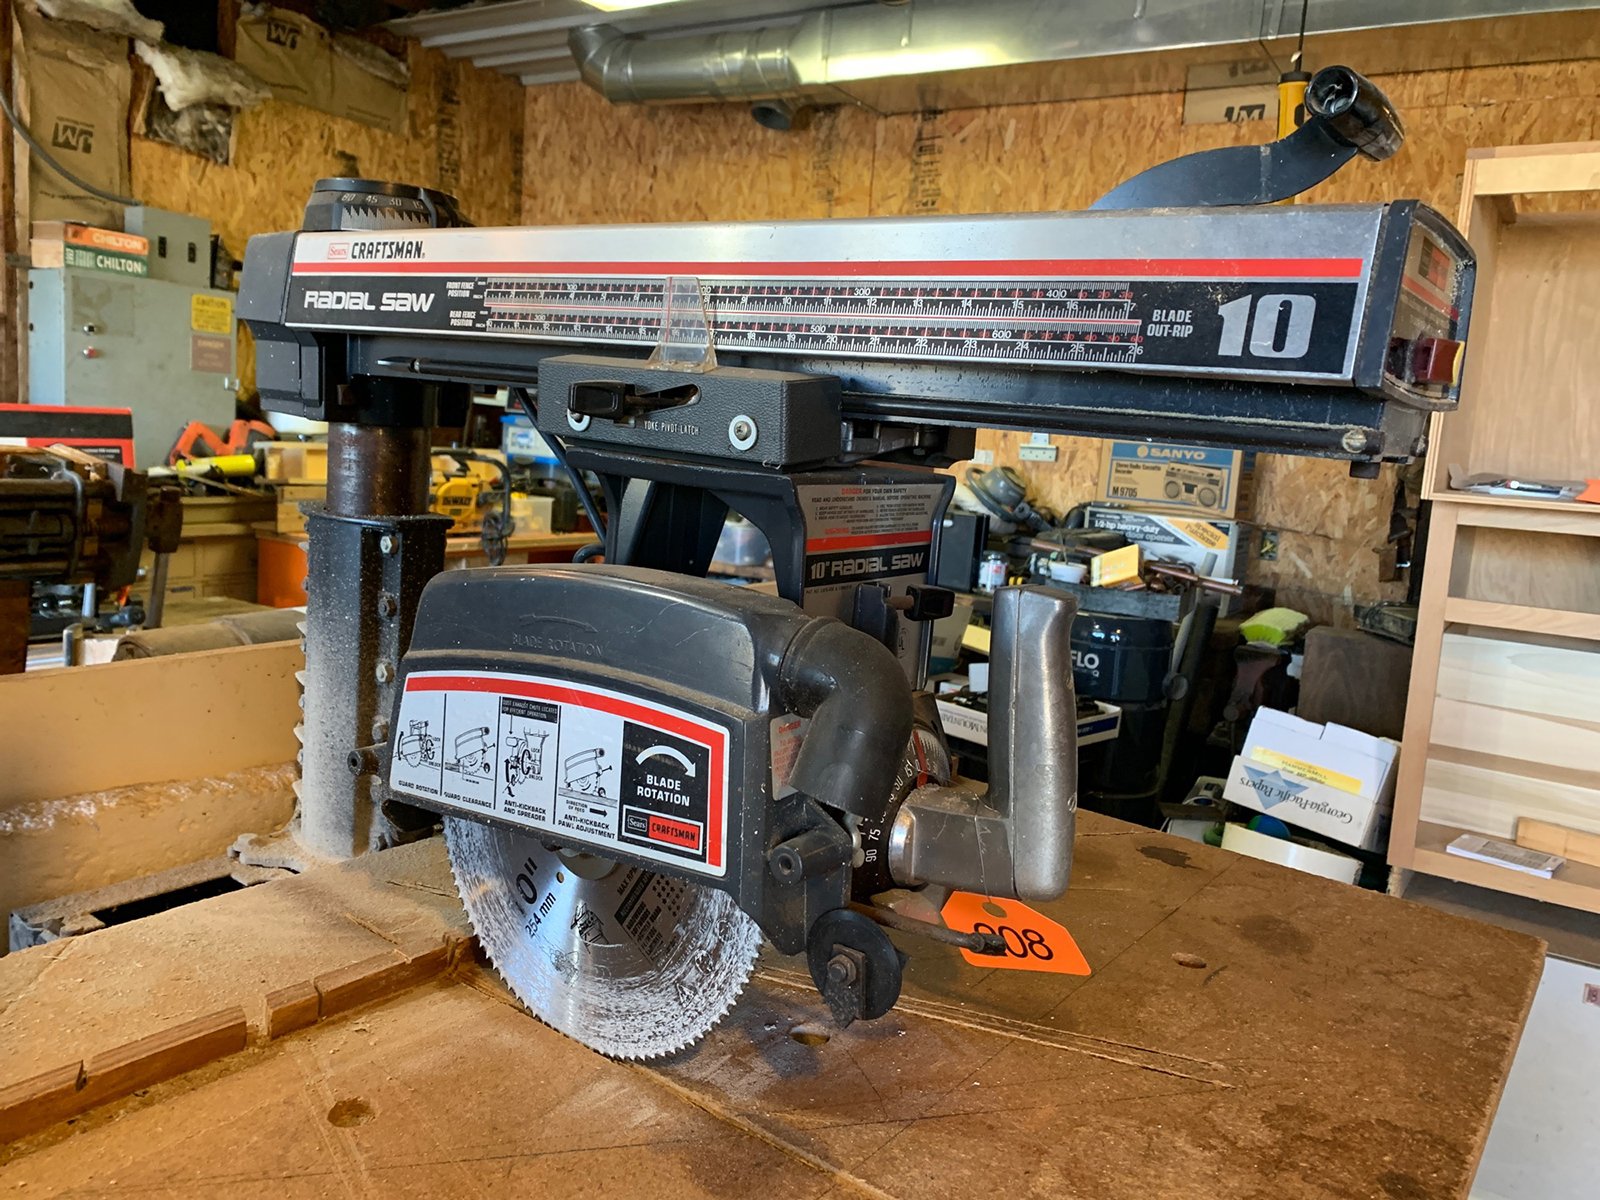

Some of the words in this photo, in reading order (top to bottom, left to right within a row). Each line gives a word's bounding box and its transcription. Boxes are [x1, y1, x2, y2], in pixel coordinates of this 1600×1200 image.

[366, 195, 378, 204] 45
[390, 198, 402, 206] 30
[413, 201, 424, 210] 15
[352, 241, 424, 260] CRAFTSMAN
[97, 256, 142, 274] CHILTON
[854, 288, 871, 296] 300
[1046, 290, 1067, 298] 400
[782, 296, 792, 304] 10
[912, 298, 924, 307] 13
[962, 300, 972, 308] 14
[1012, 300, 1024, 309] 15
[1066, 301, 1078, 310] 16
[1124, 302, 1136, 311] 17
[1152, 308, 1192, 324] BLADE
[1147, 322, 1194, 338] OUT-RIP
[1218, 293, 1317, 358] 10
[787, 332, 796, 341] 19
[826, 335, 838, 344] 20
[869, 336, 880, 344] 21
[915, 337, 928, 346] 22
[964, 339, 978, 349] 23
[1016, 341, 1028, 351] 24
[1070, 342, 1084, 352] 25
[1128, 344, 1144, 354] 26
[992, 330, 1012, 339] 600
[1084, 334, 1098, 342] 40
[1130, 335, 1144, 343] 60
[644, 420, 660, 432] YOKE
[660, 422, 678, 434] PIVOT
[680, 424, 700, 436] LATCH
[1150, 448, 1206, 460] SANYO
[1112, 486, 1119, 496] M
[1120, 486, 1138, 498] 9705
[1117, 521, 1160, 534] heavy-duty
[1126, 531, 1144, 540] door
[810, 559, 830, 580] 10"
[512, 632, 543, 648] BLADE
[548, 638, 603, 656] ROTATION
[398, 780, 415, 789] GUARD
[416, 784, 439, 795] ROTATION
[646, 774, 682, 791] BLADE
[1240, 776, 1272, 798] Papers
[444, 791, 462, 802] GUARD
[462, 796, 492, 809] CLEARANCE
[566, 800, 588, 808] DIRECTION
[636, 786, 690, 807] ROTATION
[504, 800, 547, 815] ANTI-KICKBACK
[504, 806, 516, 815] AND
[517, 810, 546, 822] SPREADER
[1274, 787, 1354, 825] Georgia-Pacific
[558, 820, 574, 829] PAWL
[576, 824, 616, 840] ADJUSTMENT
[564, 814, 610, 830] ANTI-KICKBACK
[628, 817, 646, 829] Sears
[652, 822, 696, 842] CRAFTSMAN
[869, 828, 881, 842] 75
[866, 849, 878, 862] 90
[616, 881, 628, 896] MAX
[525, 912, 541, 938] 254
[540, 892, 556, 917] mm
